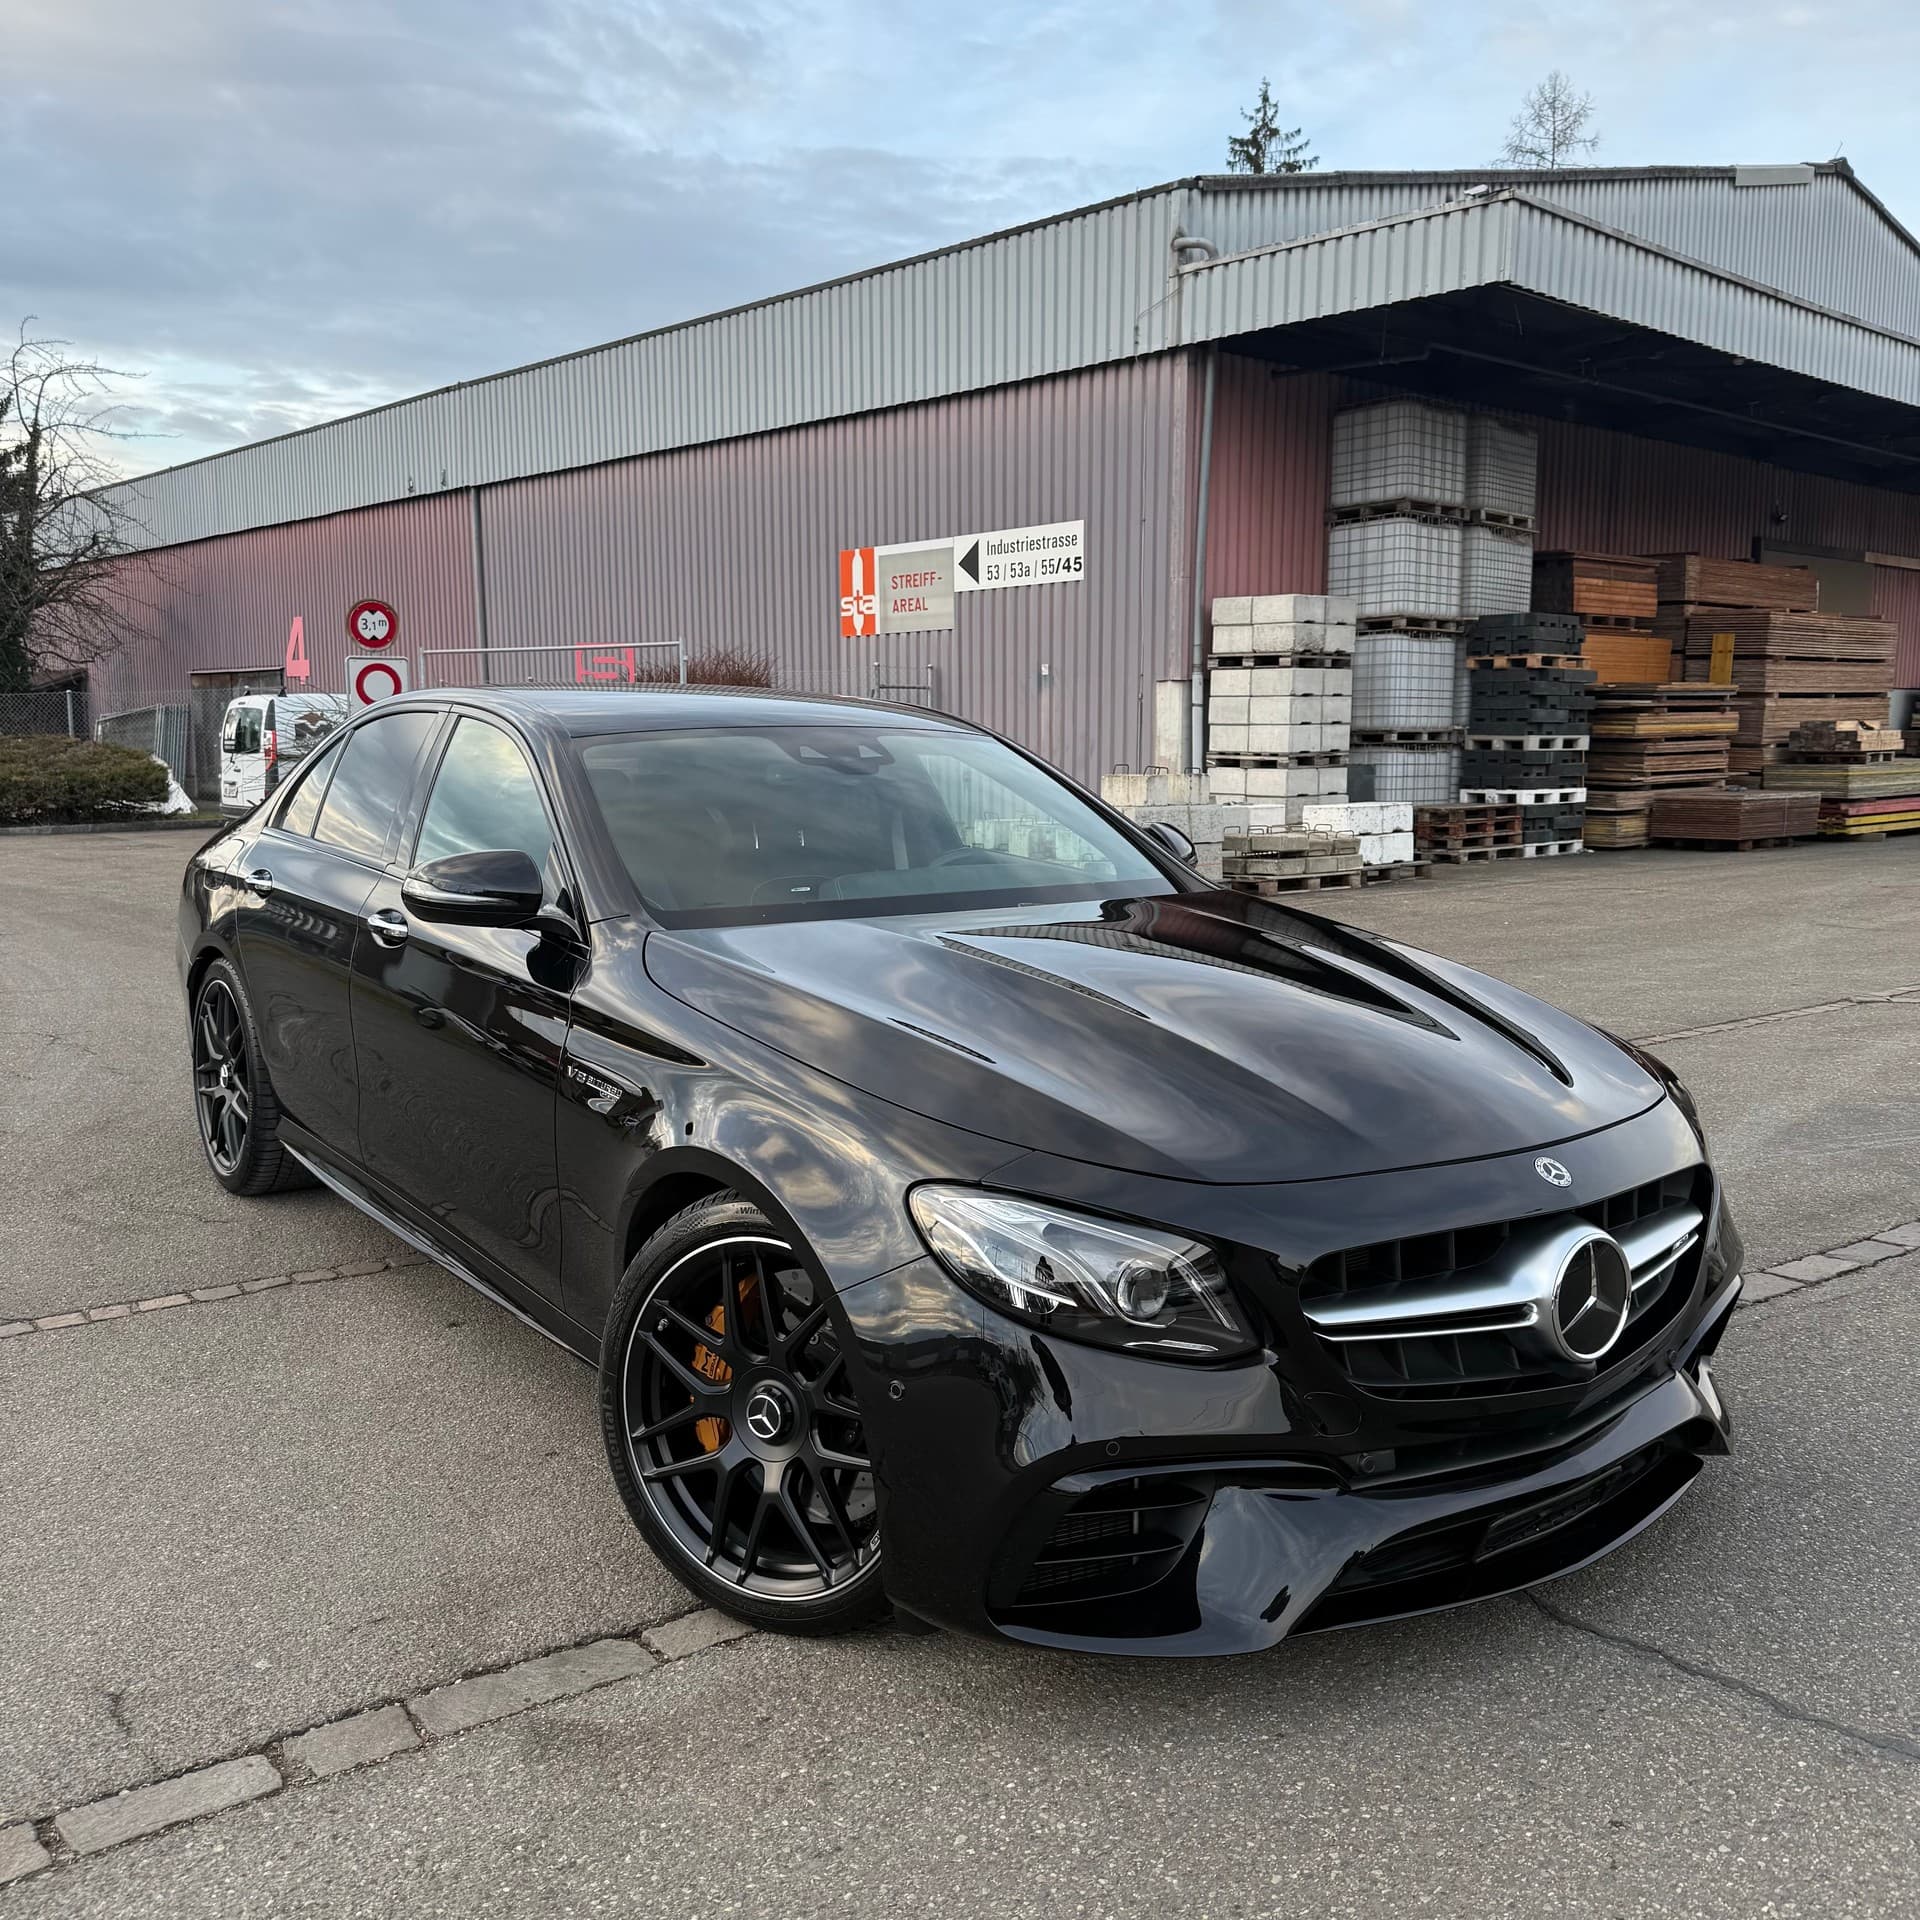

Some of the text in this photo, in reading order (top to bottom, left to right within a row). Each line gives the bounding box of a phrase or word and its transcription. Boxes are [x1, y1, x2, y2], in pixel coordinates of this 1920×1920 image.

[987, 534, 1078, 556] Industriestrasse
[891, 571, 943, 590] STREIFF-
[987, 564, 1000, 581] 53
[1010, 561, 1031, 578] 53a
[892, 596, 929, 614] AREAL
[286, 616, 310, 685] 4
